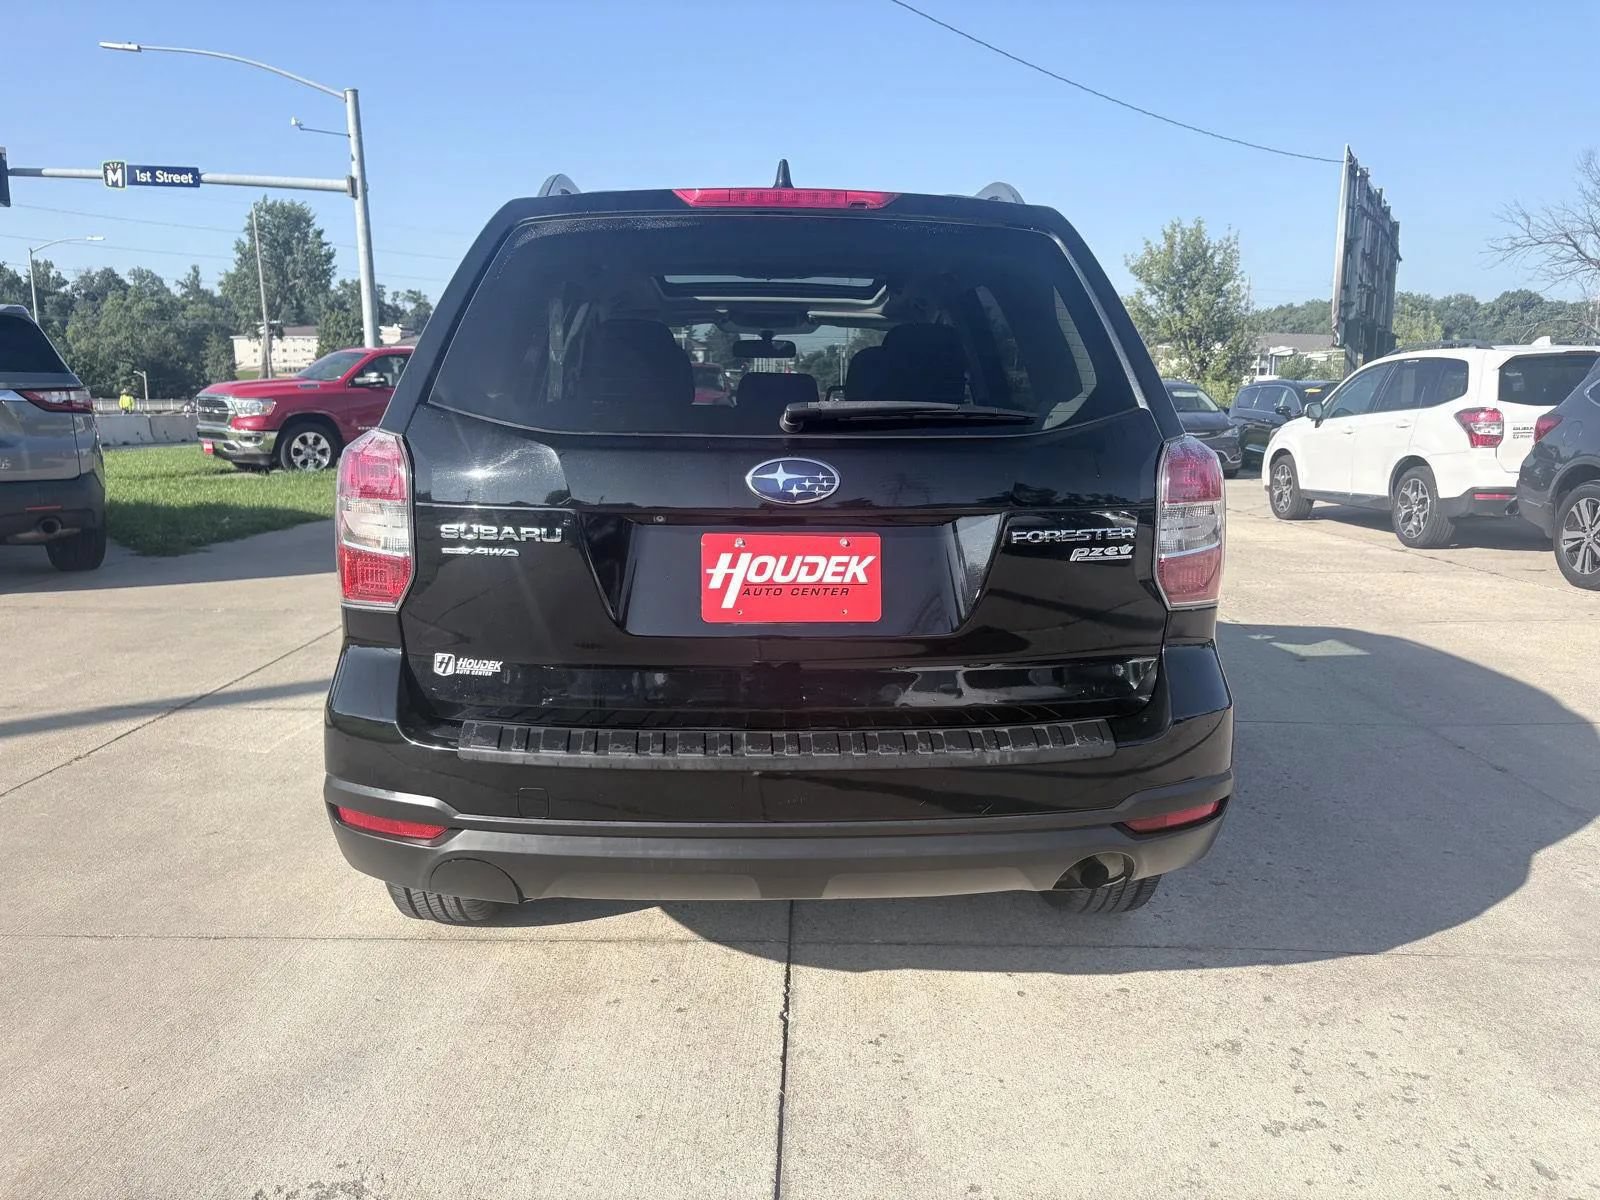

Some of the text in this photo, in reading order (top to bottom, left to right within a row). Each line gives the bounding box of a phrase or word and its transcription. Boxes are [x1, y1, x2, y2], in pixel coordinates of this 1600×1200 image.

[135, 169, 194, 184] 1st Street
[440, 523, 562, 543] SUBARU
[1011, 527, 1137, 544] FORESTER
[705, 552, 876, 609] HOUDEK
[742, 587, 850, 596] AUTO CENTER
[456, 657, 503, 671] HOUDEK
